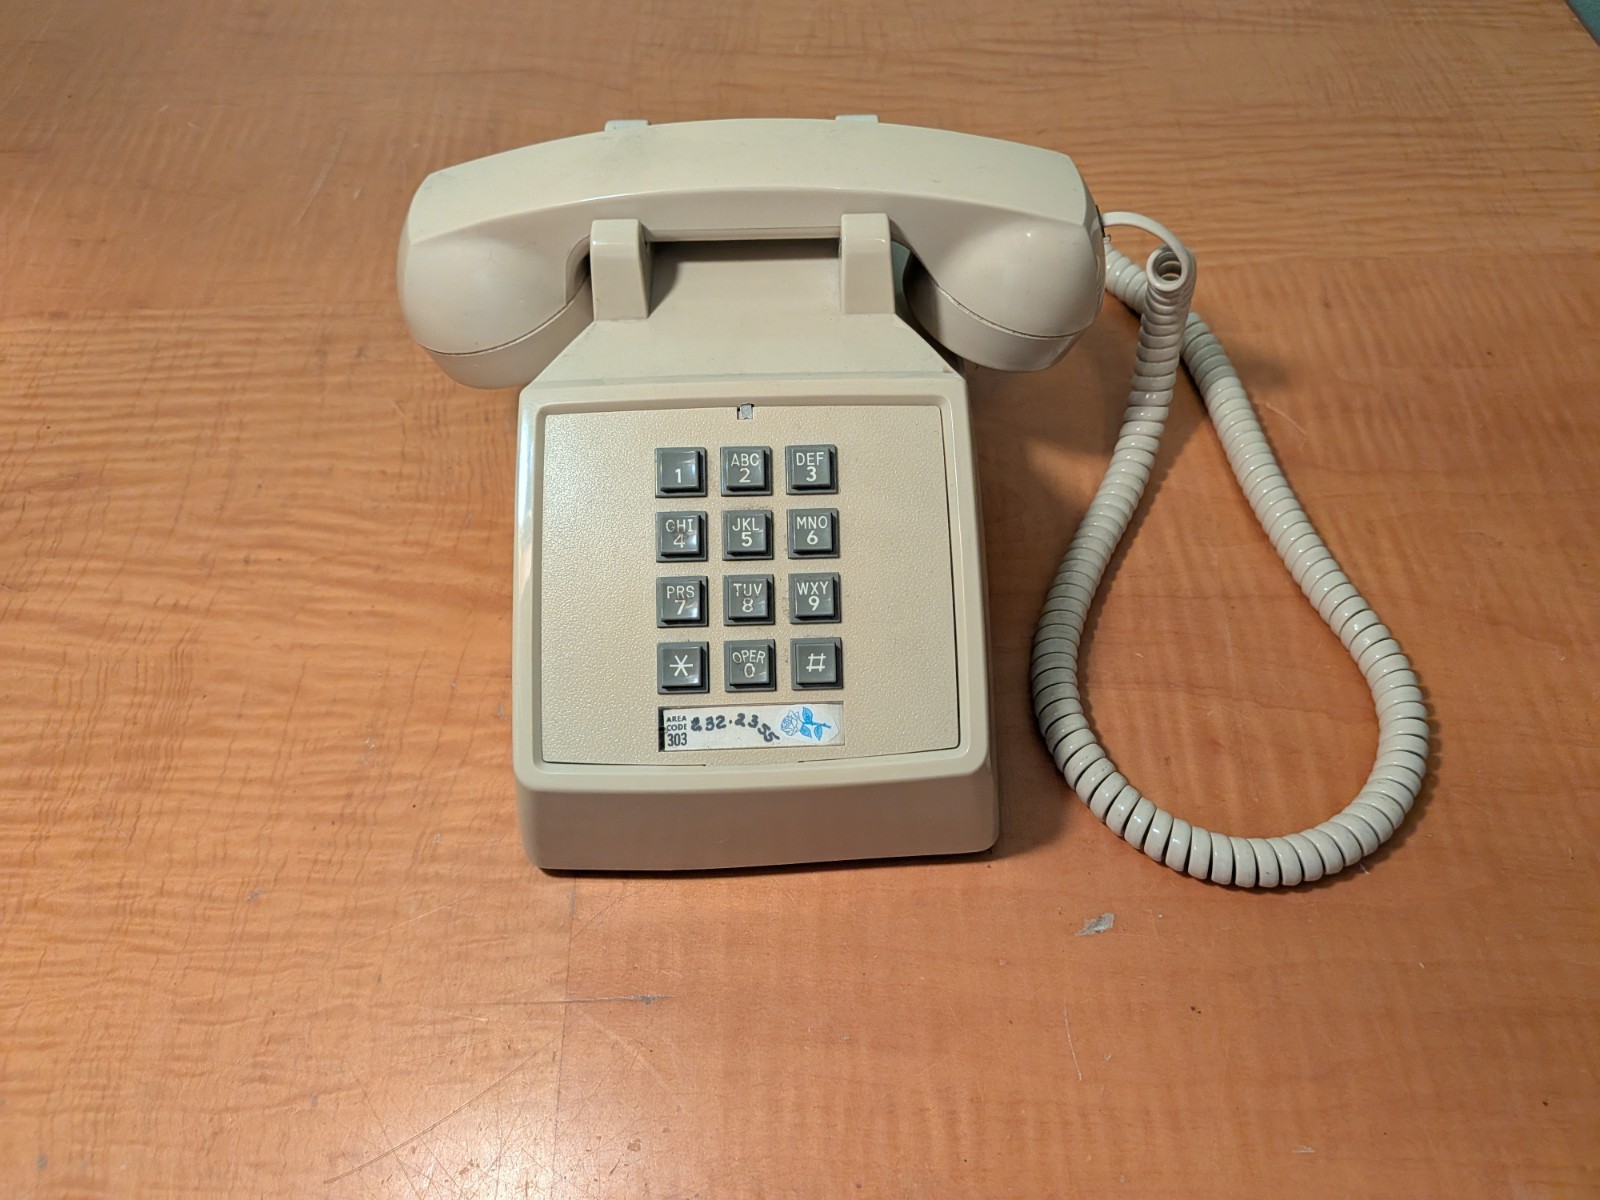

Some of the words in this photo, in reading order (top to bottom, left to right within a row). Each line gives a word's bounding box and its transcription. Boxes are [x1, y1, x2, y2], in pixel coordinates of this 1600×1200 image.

[731, 454, 759, 466] ABC
[796, 452, 824, 466] DEF
[675, 469, 682, 483] 1
[739, 468, 750, 482] 2
[806, 466, 817, 481] 3
[732, 518, 759, 531] JKL
[796, 516, 828, 529] MNO
[673, 534, 685, 548] 4
[742, 532, 752, 546] 5
[806, 530, 818, 544] 6
[666, 585, 695, 598] PRS
[733, 583, 762, 597] TUV
[797, 581, 829, 595] WXY
[674, 600, 686, 615] 7
[742, 598, 753, 613] 8
[808, 596, 820, 611] 9
[732, 650, 766, 664] OPER
[744, 663, 755, 678] 0
[666, 715, 687, 723] AREA
[666, 724, 687, 732] CODE
[667, 733, 687, 747] 303
